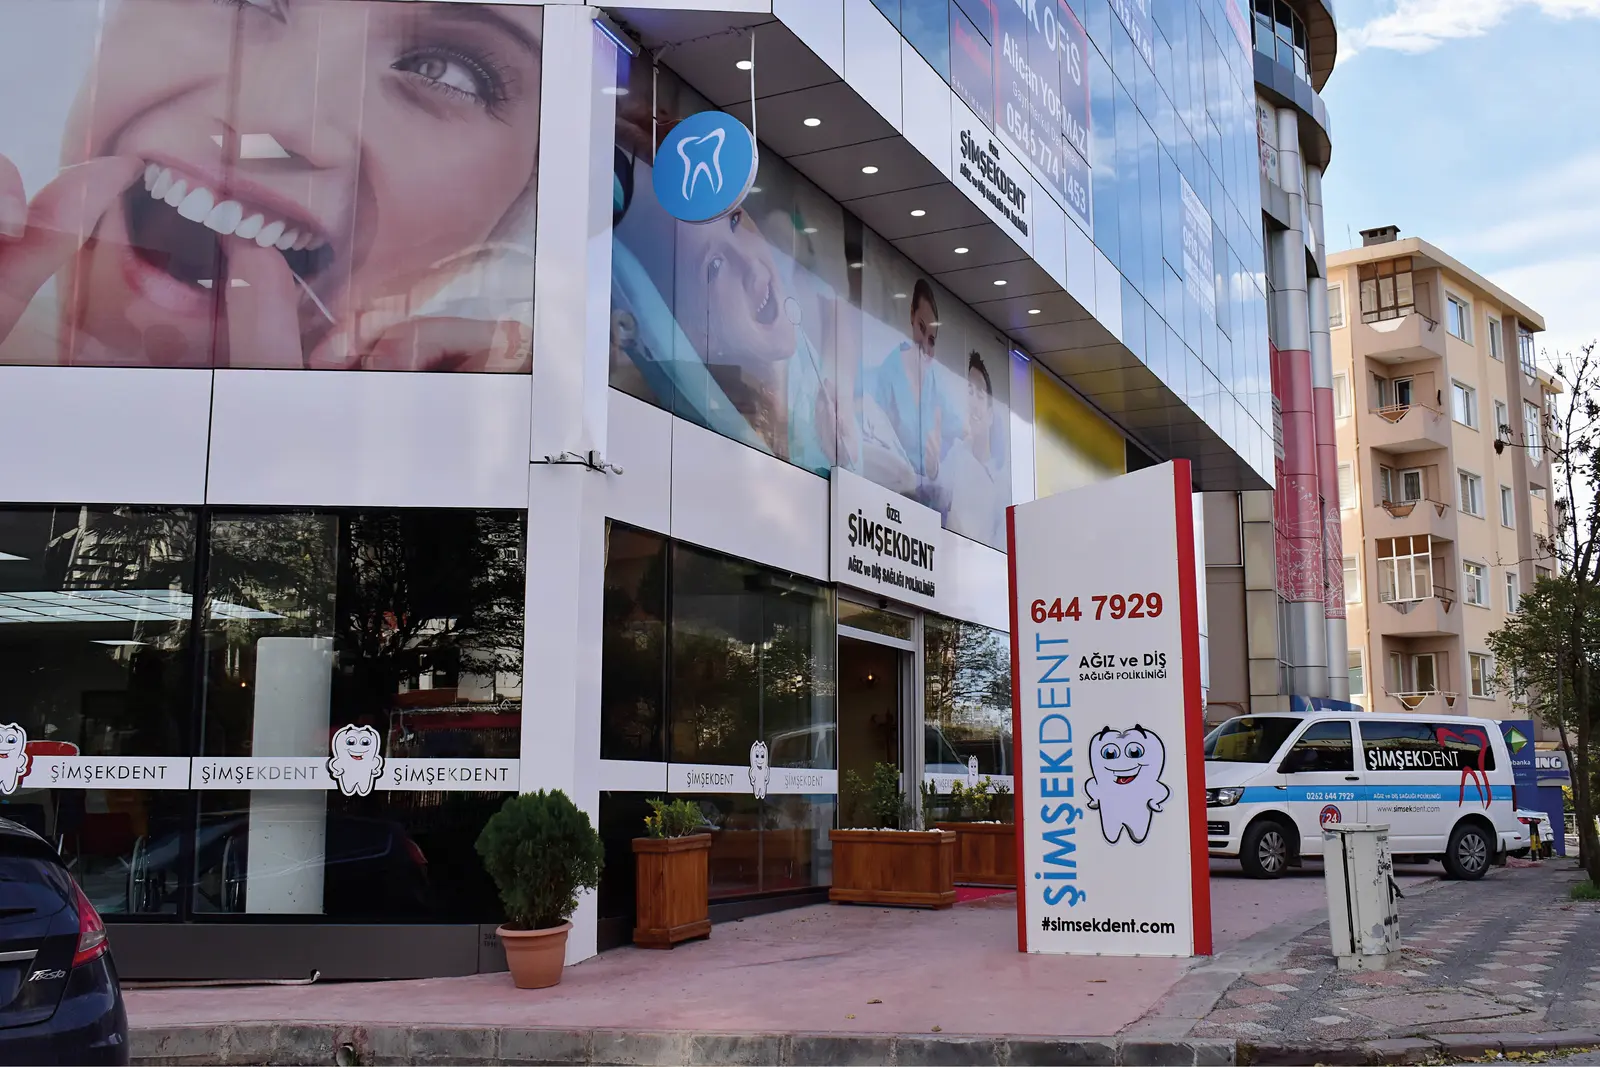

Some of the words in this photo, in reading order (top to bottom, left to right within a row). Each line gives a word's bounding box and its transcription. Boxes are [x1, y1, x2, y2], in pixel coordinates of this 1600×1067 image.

[1003, 31, 1038, 97] Alican
[1006, 102, 1037, 157] 0545
[1038, 136, 1060, 184] 774
[1061, 167, 1087, 215] 1453
[959, 128, 1027, 215] ŞİMŞEKDENT
[886, 502, 903, 525] ÖZEL
[847, 508, 935, 572] ŞİMŞEKDENT
[847, 554, 864, 575] AĞIZ
[863, 564, 872, 577] ve
[871, 562, 882, 584] DİŞ
[1030, 598, 1082, 624] 644
[1091, 592, 1163, 621] 7929
[1078, 650, 1115, 669] AĞIZ
[1119, 656, 1139, 669] ve
[1142, 650, 1167, 670] DİŞ
[1078, 669, 1115, 682] SAĞLIĞI
[1115, 668, 1168, 681] POLİKLİNİĞİ
[1368, 746, 1459, 771] ŞİMŞEKDENT
[50, 763, 168, 784] ŞİMŞEKDENT
[201, 762, 319, 784] ŞİMŞEKDENT
[393, 764, 509, 786] ŞİMŞEKDENT
[686, 769, 734, 788] ŞİMŞEKDENT
[784, 772, 824, 789] ŞİMŞEKDENT
[1034, 632, 1086, 909] ŞİMŞEKDENT
[1306, 792, 1324, 800] 0262
[1324, 792, 1337, 800] 644
[1338, 792, 1355, 800] 7929
[1041, 916, 1176, 934] #simsekdent.com
